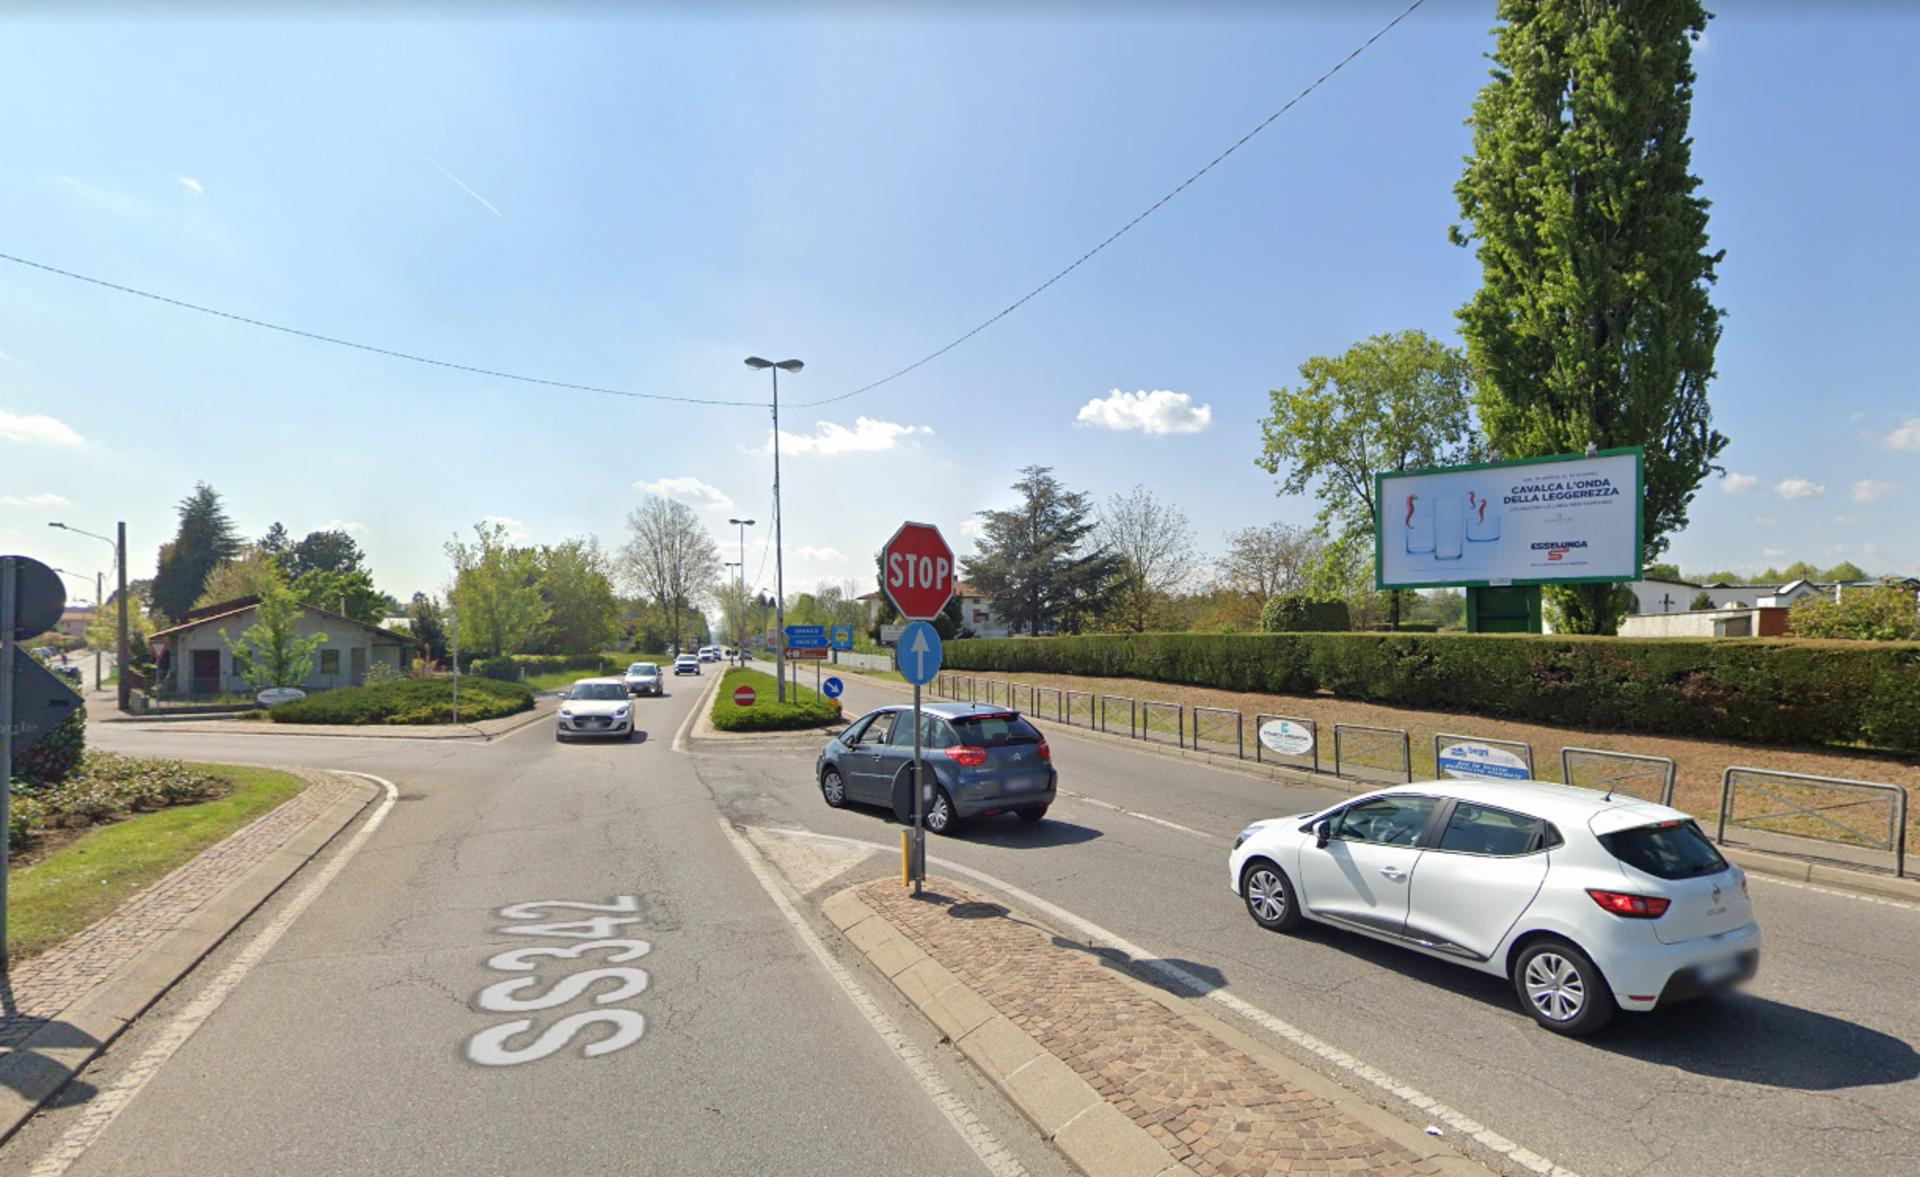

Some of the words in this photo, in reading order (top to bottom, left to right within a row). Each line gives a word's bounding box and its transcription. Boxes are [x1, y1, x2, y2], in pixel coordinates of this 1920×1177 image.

[1511, 483, 1564, 494] CAVALCA
[1566, 478, 1611, 490] L'ONDA
[1503, 494, 1540, 504] DELLA
[1542, 487, 1620, 501] LEGGEREZZA
[1530, 540, 1588, 550] ESSELUNGA
[889, 552, 949, 590] STOP
[467, 895, 650, 1066] SS342
